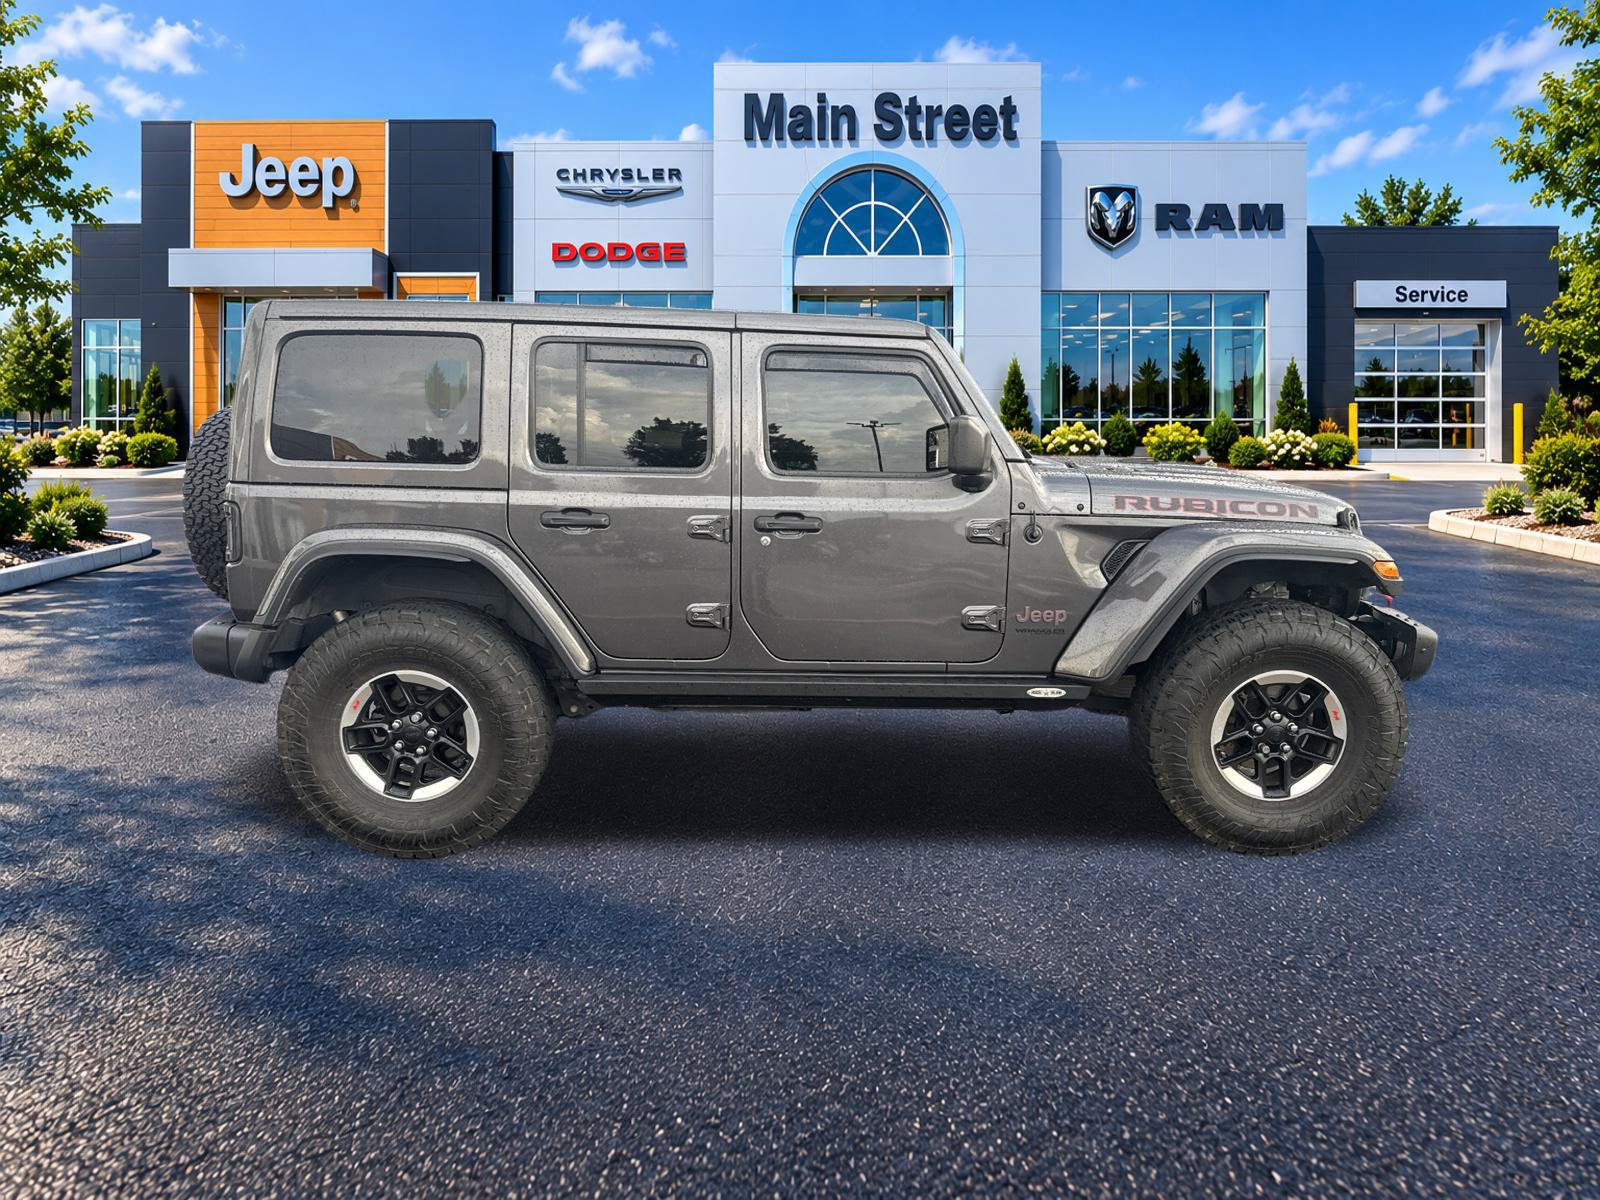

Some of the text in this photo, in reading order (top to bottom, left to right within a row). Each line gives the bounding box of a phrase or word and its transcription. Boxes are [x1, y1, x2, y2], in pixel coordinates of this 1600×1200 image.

[744, 91, 1018, 142] Main Street
[218, 143, 356, 209] Jeep
[556, 167, 683, 182] CHRYSLER
[1155, 203, 1284, 232] RAM
[551, 242, 687, 262] DODGE
[1395, 285, 1469, 303] Service
[1114, 495, 1320, 519] RUBICON
[1015, 605, 1067, 626] Jeep
